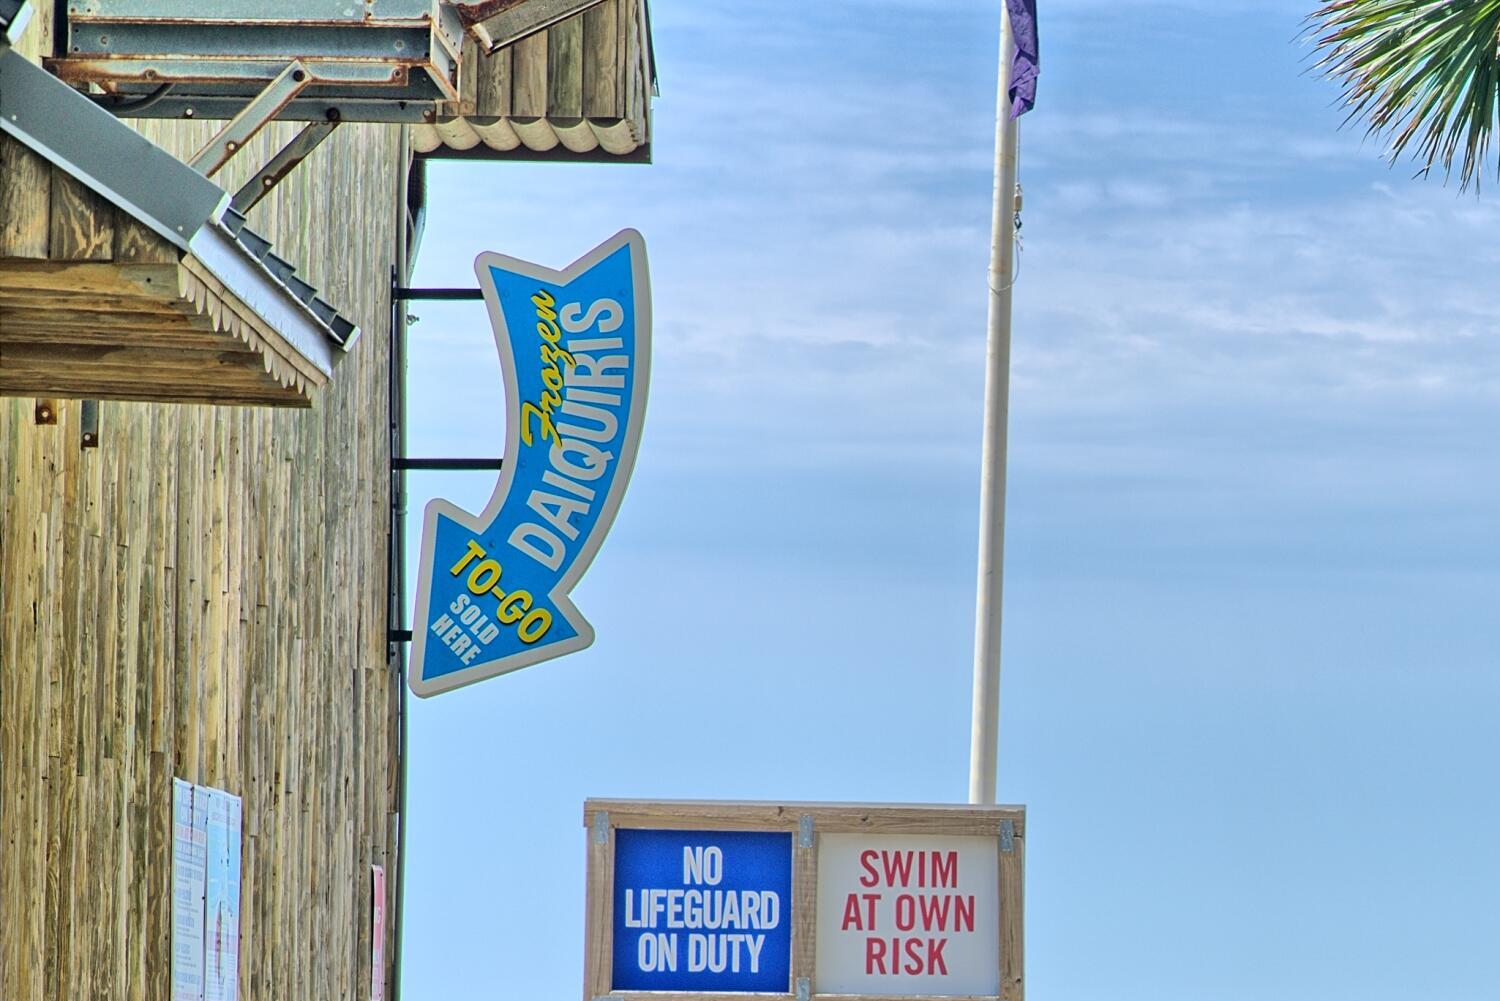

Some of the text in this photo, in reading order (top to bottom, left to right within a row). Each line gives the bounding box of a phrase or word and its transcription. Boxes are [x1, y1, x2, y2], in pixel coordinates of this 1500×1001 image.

[520, 288, 576, 448] Frozen
[507, 296, 629, 572] DAIQUIRIS
[449, 539, 553, 646] TO-GO
[430, 612, 482, 666] HERE
[449, 593, 499, 646] SOLD
[683, 846, 723, 885] NO
[859, 849, 959, 889] SWIM
[625, 889, 780, 930] LIFEGUARD
[841, 894, 975, 932] AT OWN
[638, 933, 765, 973] ON DUTY
[865, 937, 948, 976] RISK
